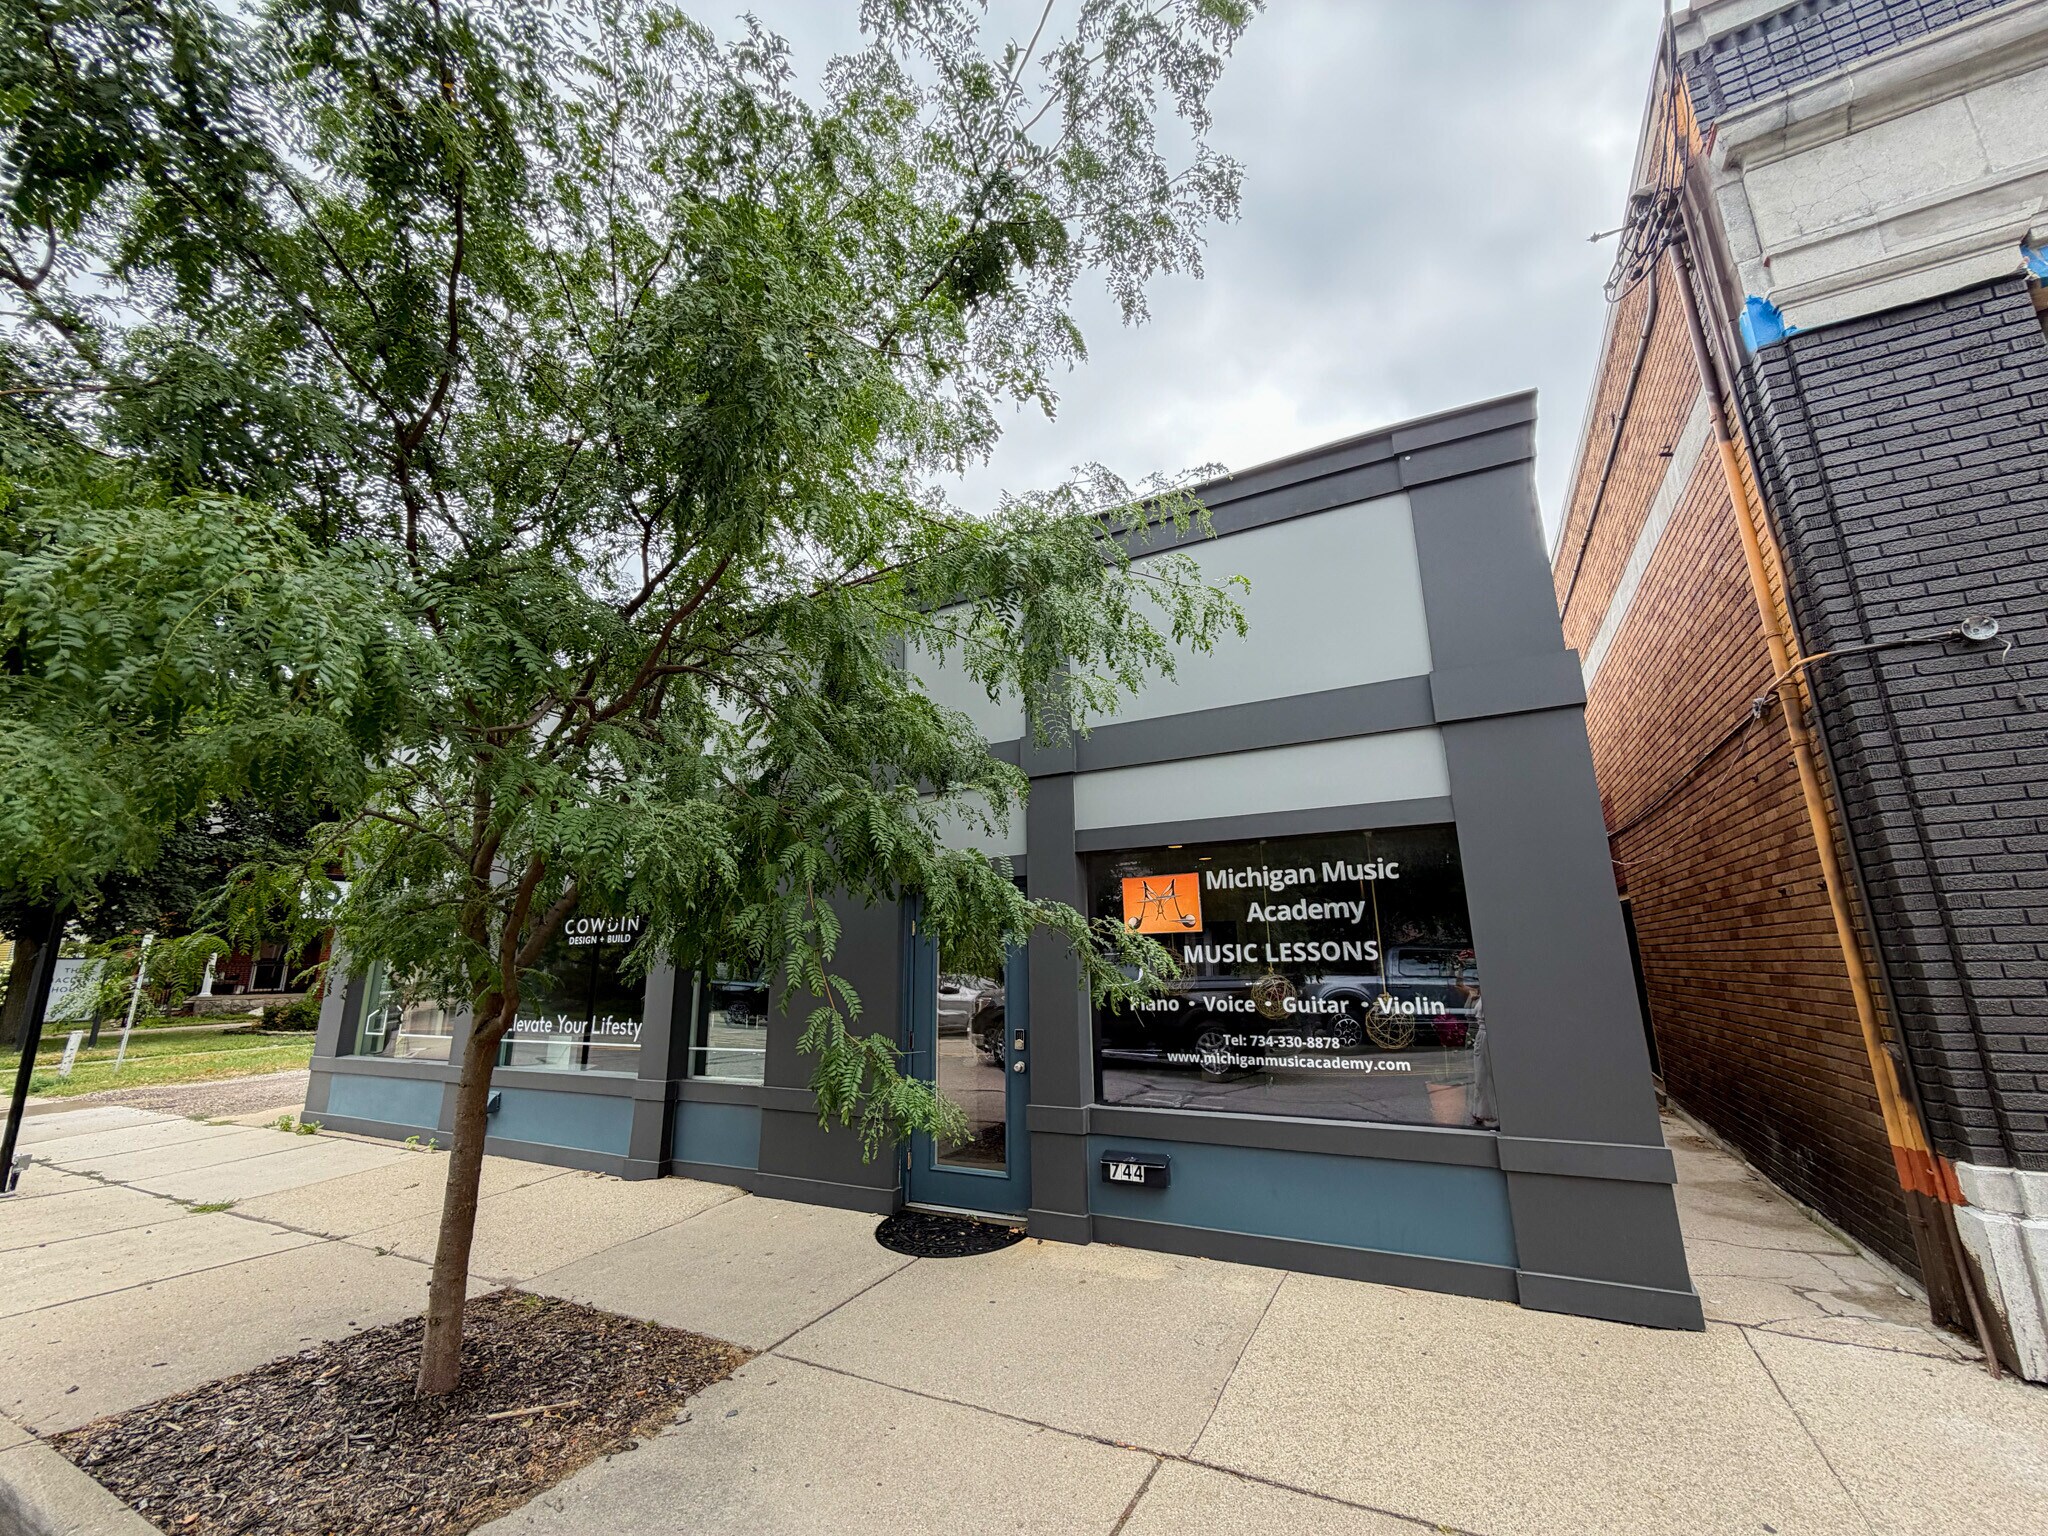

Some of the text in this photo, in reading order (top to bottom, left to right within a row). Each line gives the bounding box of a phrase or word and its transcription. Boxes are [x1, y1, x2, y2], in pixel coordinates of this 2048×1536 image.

[1205, 857, 1400, 892] Michigan Music
[1246, 898, 1366, 925] Academy
[568, 935, 598, 945] DESIGN
[607, 933, 631, 944] BUILD
[1183, 940, 1380, 964] MUSIC LESSONS
[1202, 995, 1256, 1013] Voice
[1282, 996, 1350, 1014] Guitar
[1377, 996, 1445, 1015] Violin
[508, 1013, 553, 1033] levate
[557, 1014, 588, 1034] Your
[1222, 1033, 1341, 1049] Tel: 734-330-8878
[1167, 1052, 1411, 1074] www.michiganmusicacademy.com
[1111, 1163, 1143, 1181] 744
